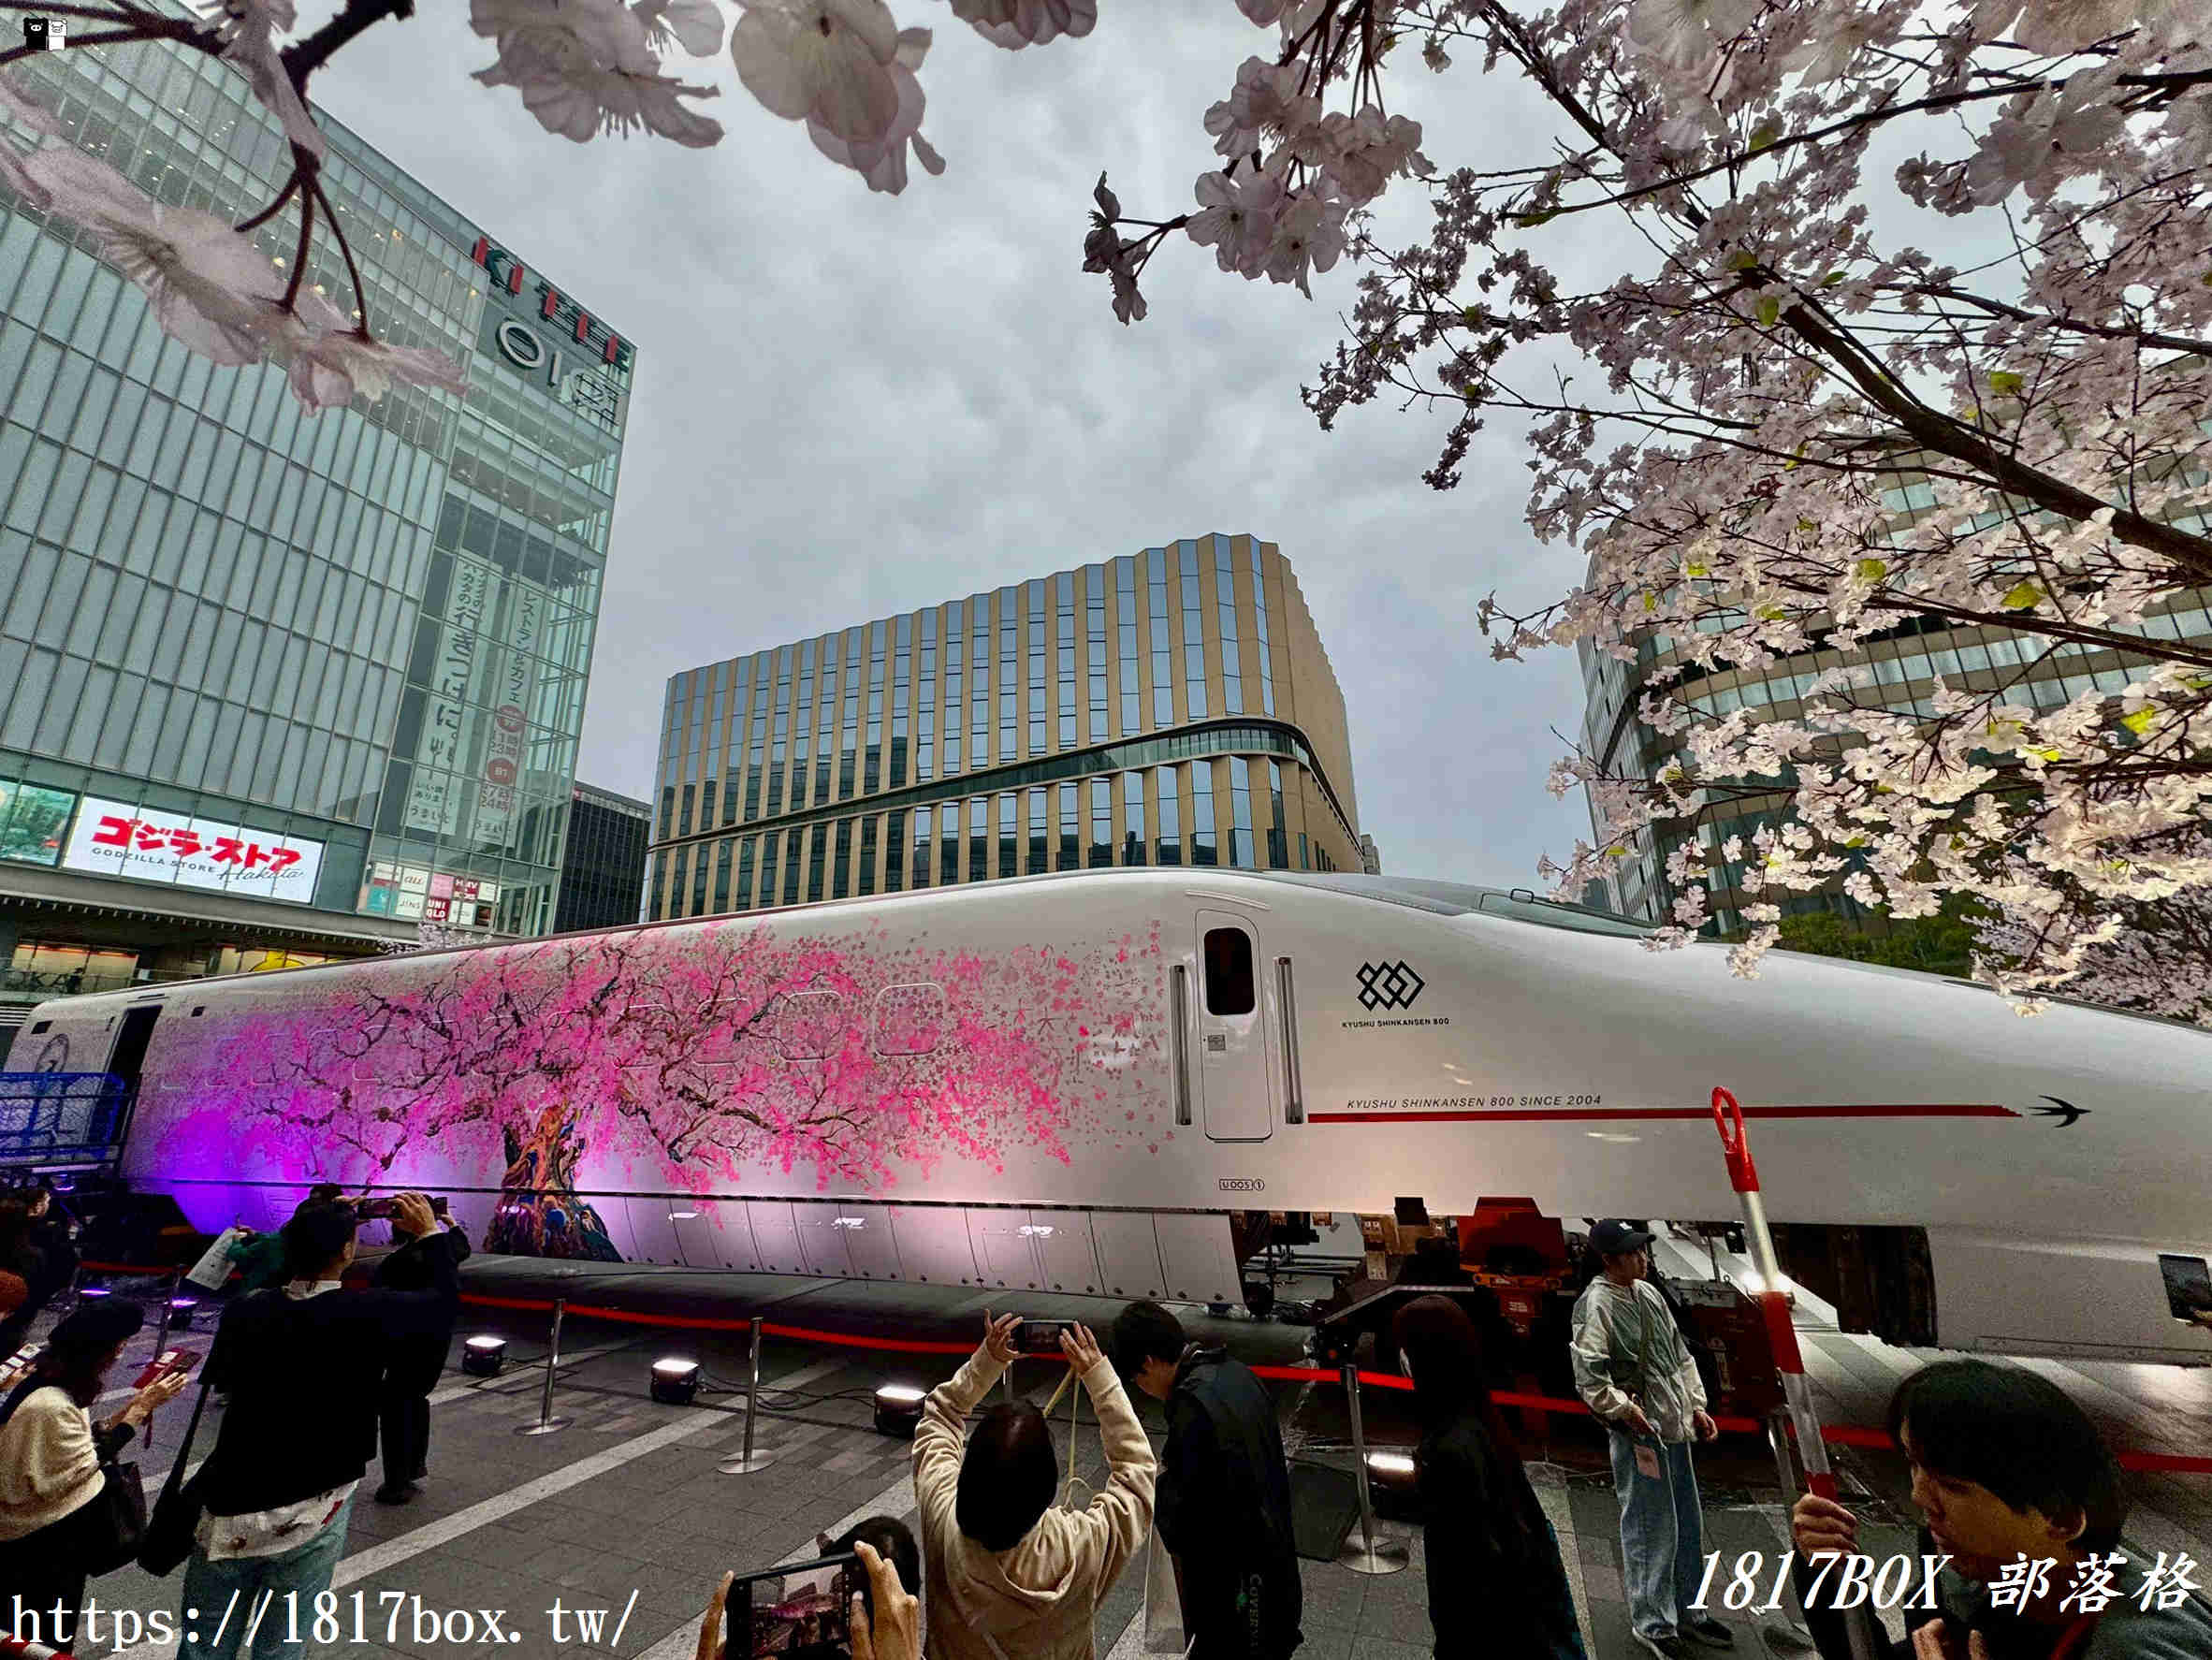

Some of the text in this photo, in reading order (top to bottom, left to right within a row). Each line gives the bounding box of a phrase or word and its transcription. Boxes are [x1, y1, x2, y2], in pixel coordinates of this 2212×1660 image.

[92, 815, 302, 872] ゴジラ・ストア
[92, 847, 219, 874] GODZILLA STORE
[428, 899, 446, 910] UNI
[1342, 1016, 1449, 1028] KYUSHU SHINKANSEN 800
[1346, 1095, 1602, 1109] KYUSHU SHINKANSEN 800 SINCE 2004
